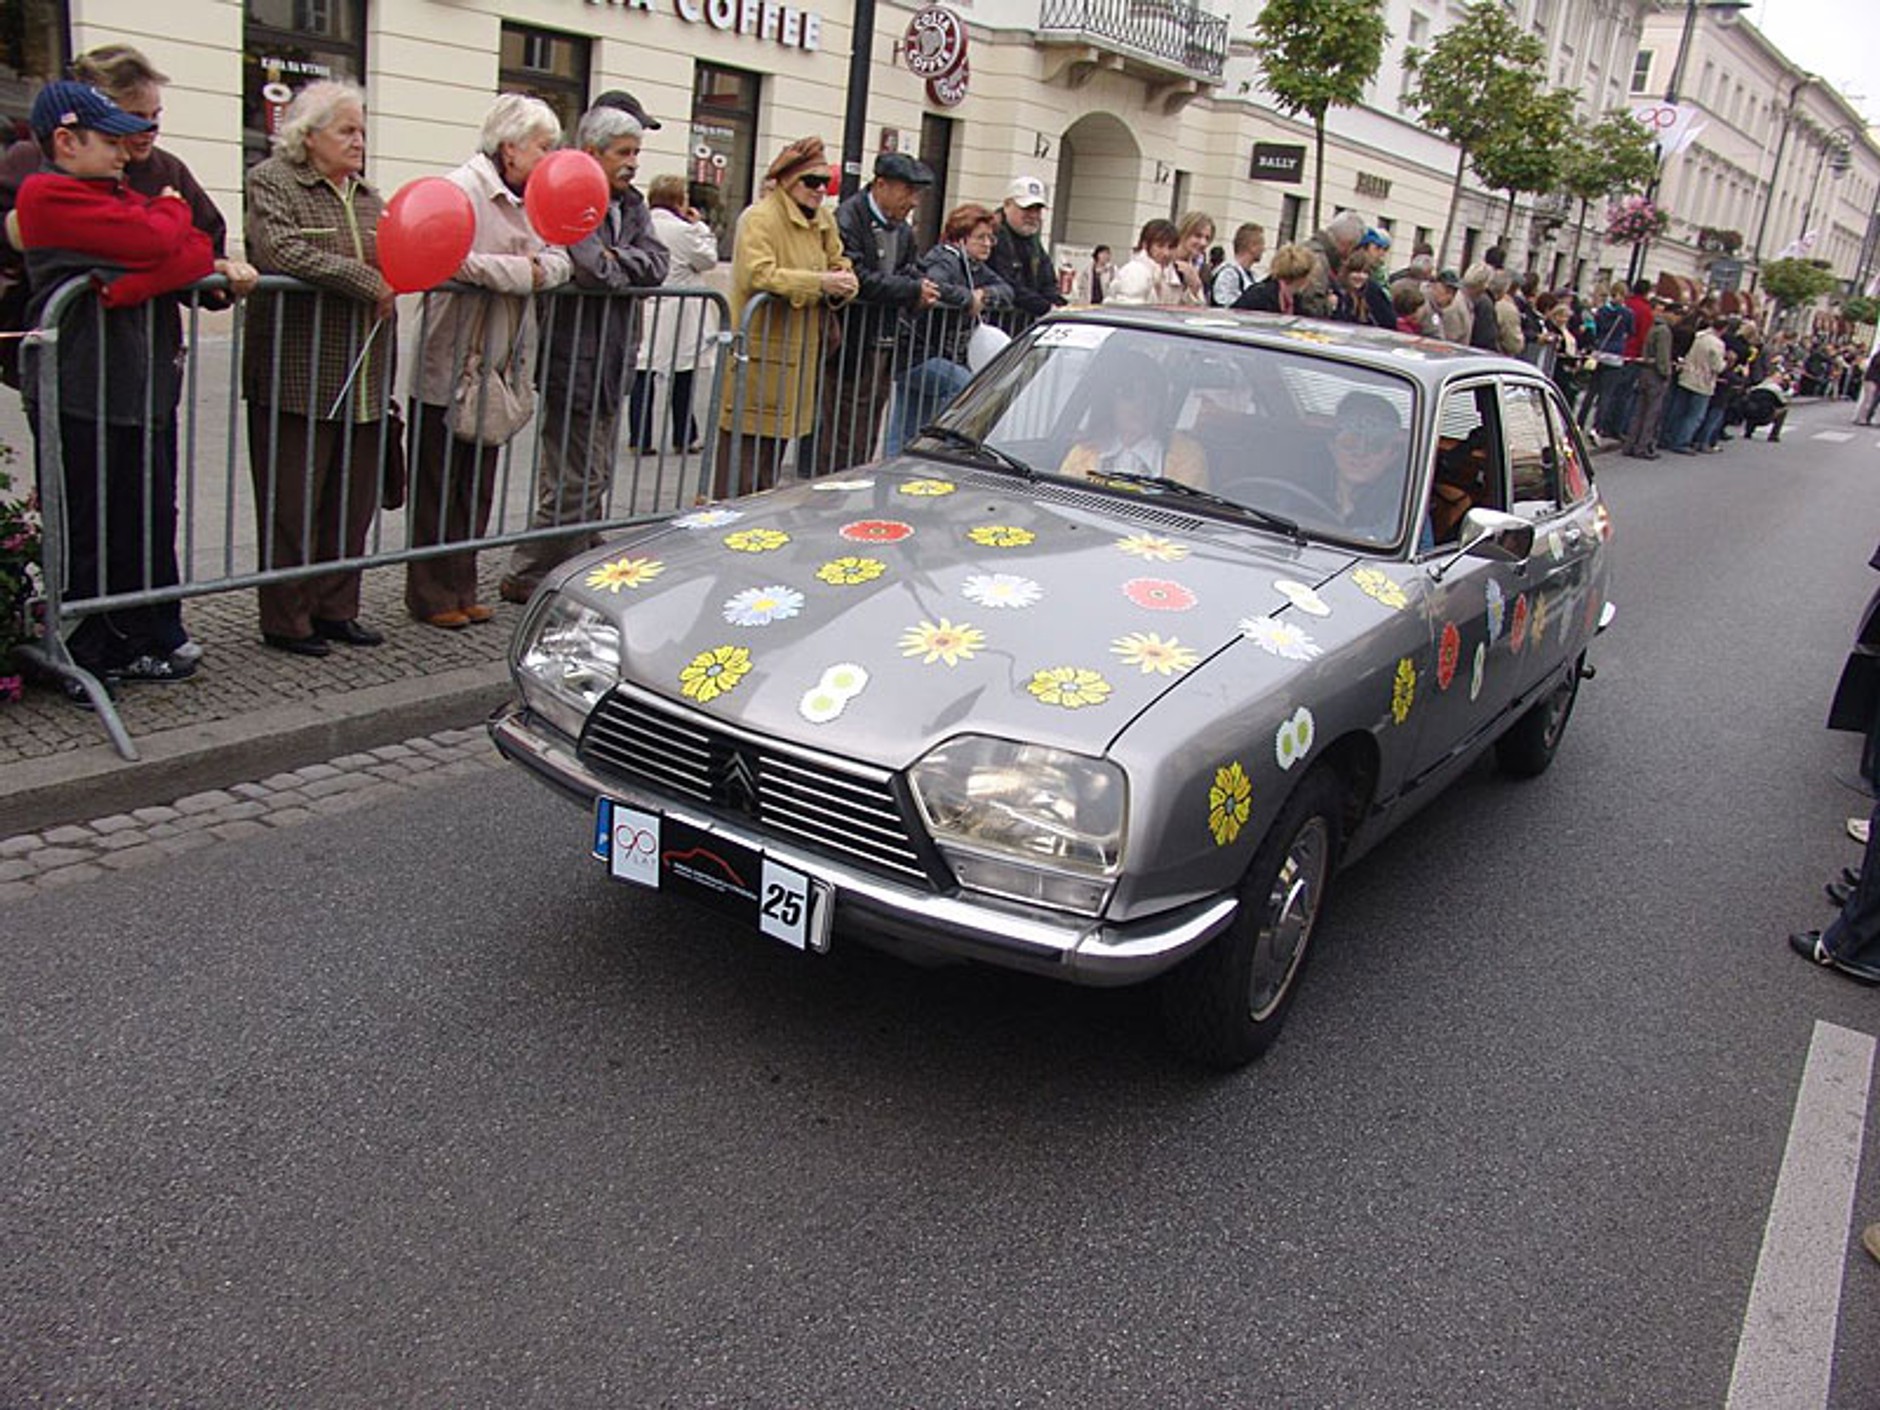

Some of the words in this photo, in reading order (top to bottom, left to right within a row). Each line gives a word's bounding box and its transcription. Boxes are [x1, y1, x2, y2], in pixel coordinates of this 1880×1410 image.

[673, 0, 822, 52] COFFEE
[914, 11, 951, 31] COSTA
[1258, 156, 1298, 169] BALLY
[762, 884, 804, 926] 25
